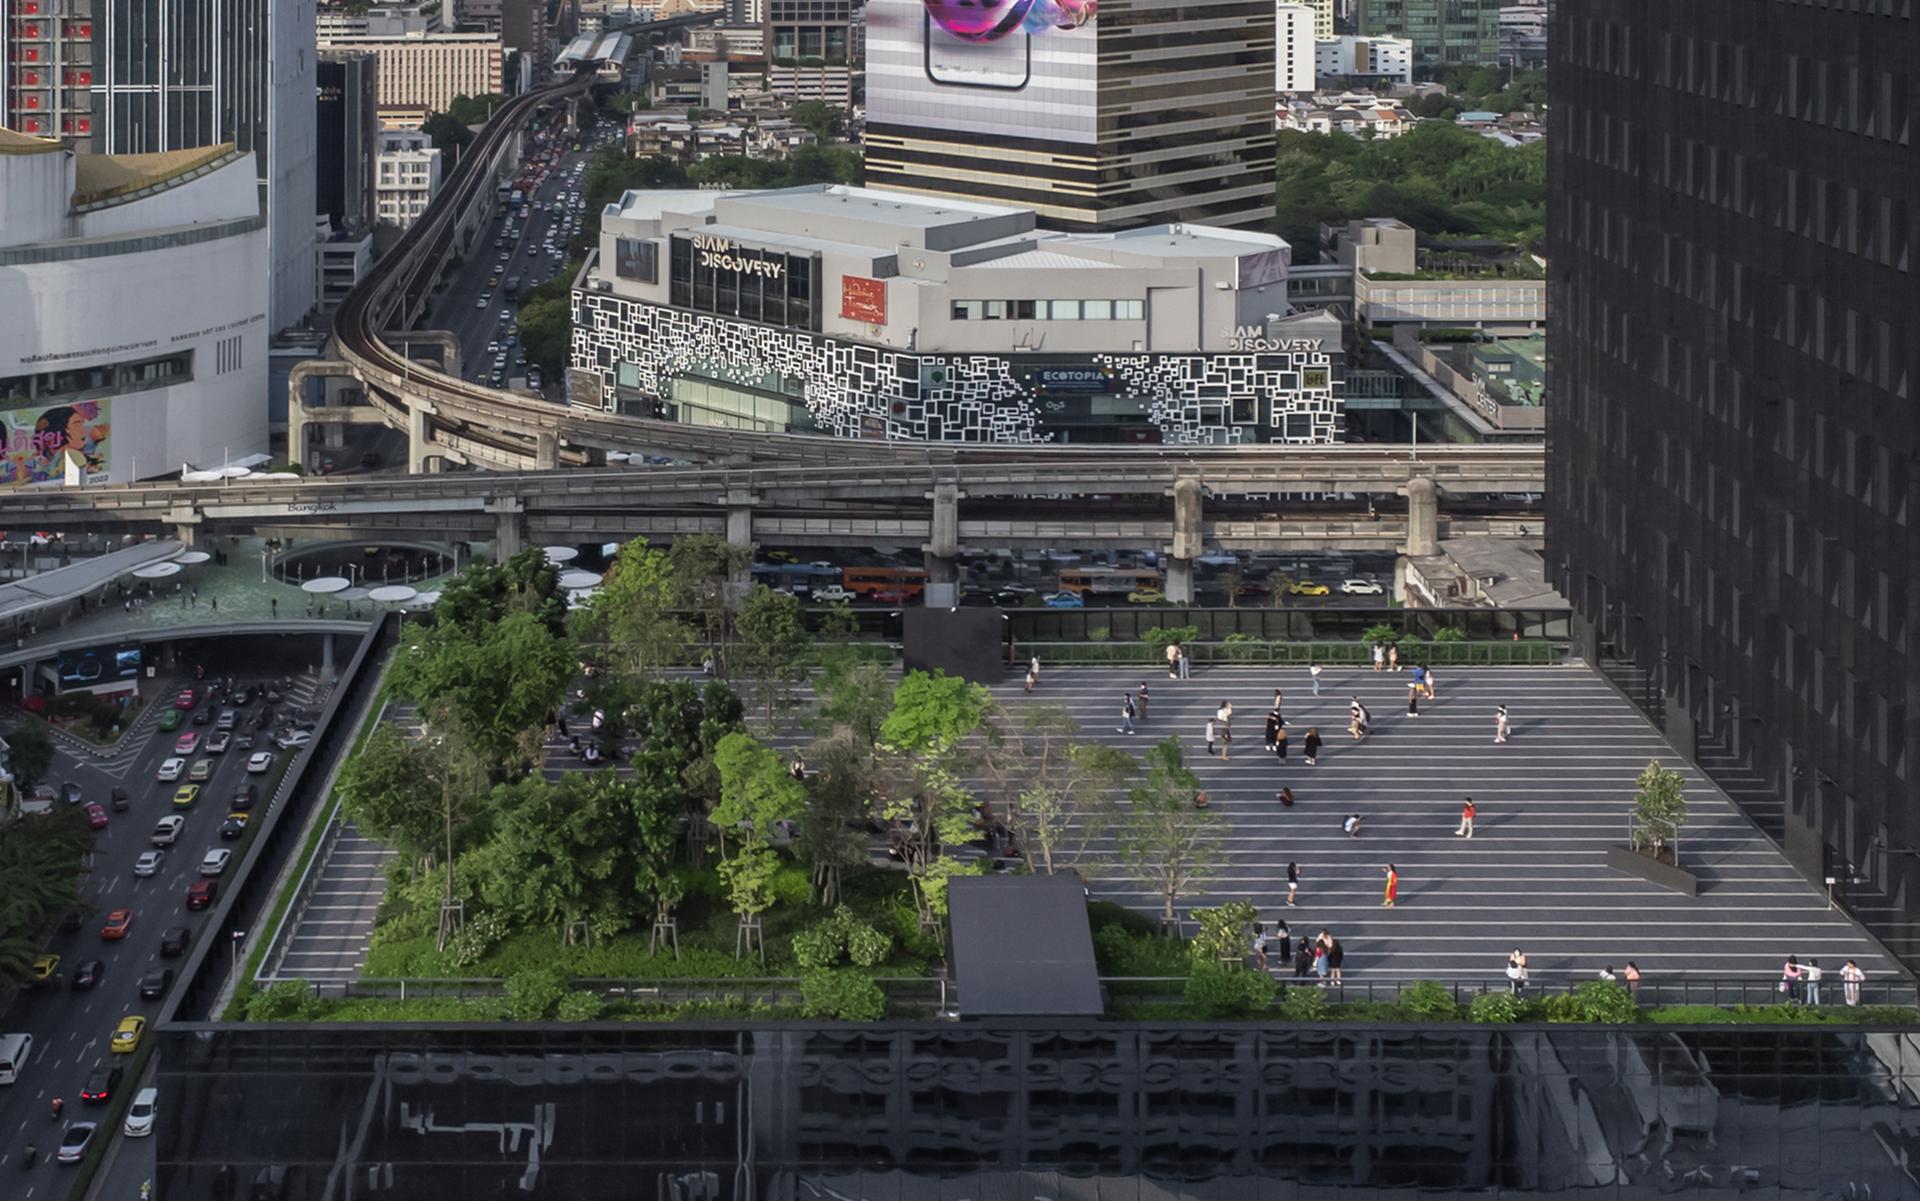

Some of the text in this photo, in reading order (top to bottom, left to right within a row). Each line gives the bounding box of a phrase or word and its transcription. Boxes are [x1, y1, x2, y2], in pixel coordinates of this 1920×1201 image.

[693, 234, 729, 252] SIAM
[701, 251, 782, 278] DISCOVERY
[1221, 325, 1262, 338] SIAM
[1229, 338, 1324, 352] DISCOVERY
[1043, 371, 1104, 380] ECOTOPIA
[287, 502, 337, 514] Bangkok
